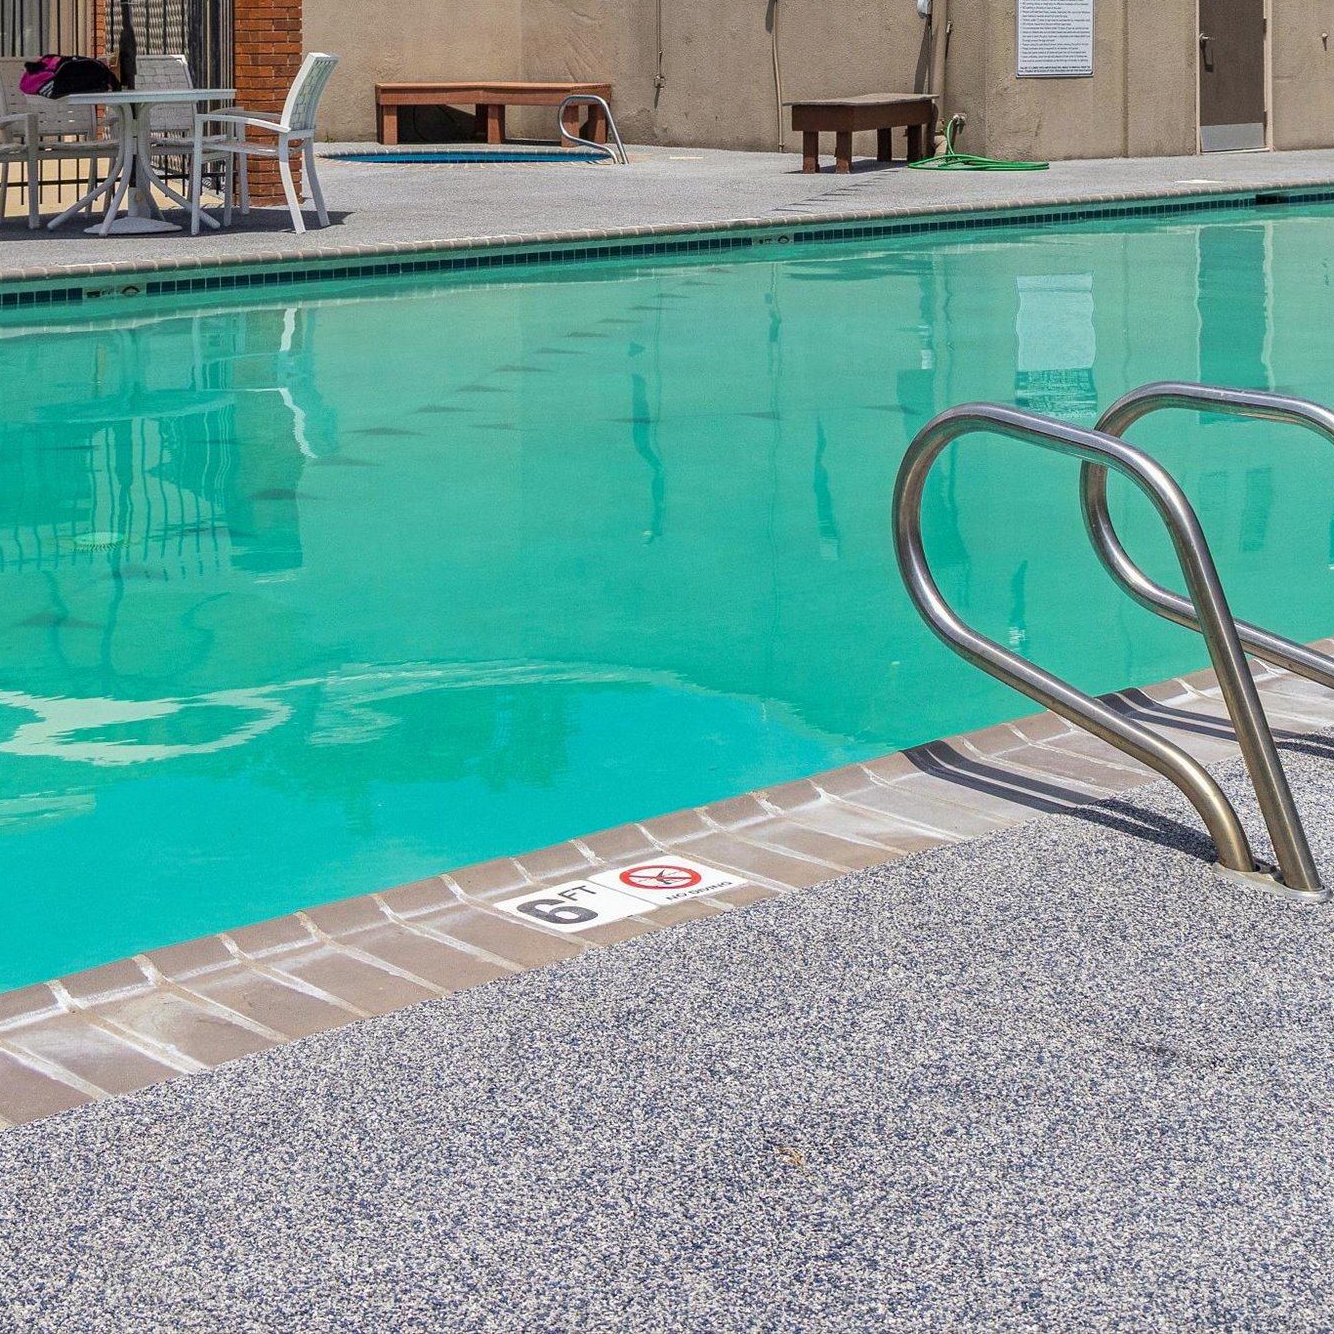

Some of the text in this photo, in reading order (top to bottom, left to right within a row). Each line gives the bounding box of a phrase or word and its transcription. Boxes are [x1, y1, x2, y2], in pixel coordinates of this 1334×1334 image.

[516, 884, 599, 925] 6 FT
[665, 880, 733, 901] NO DIVING
